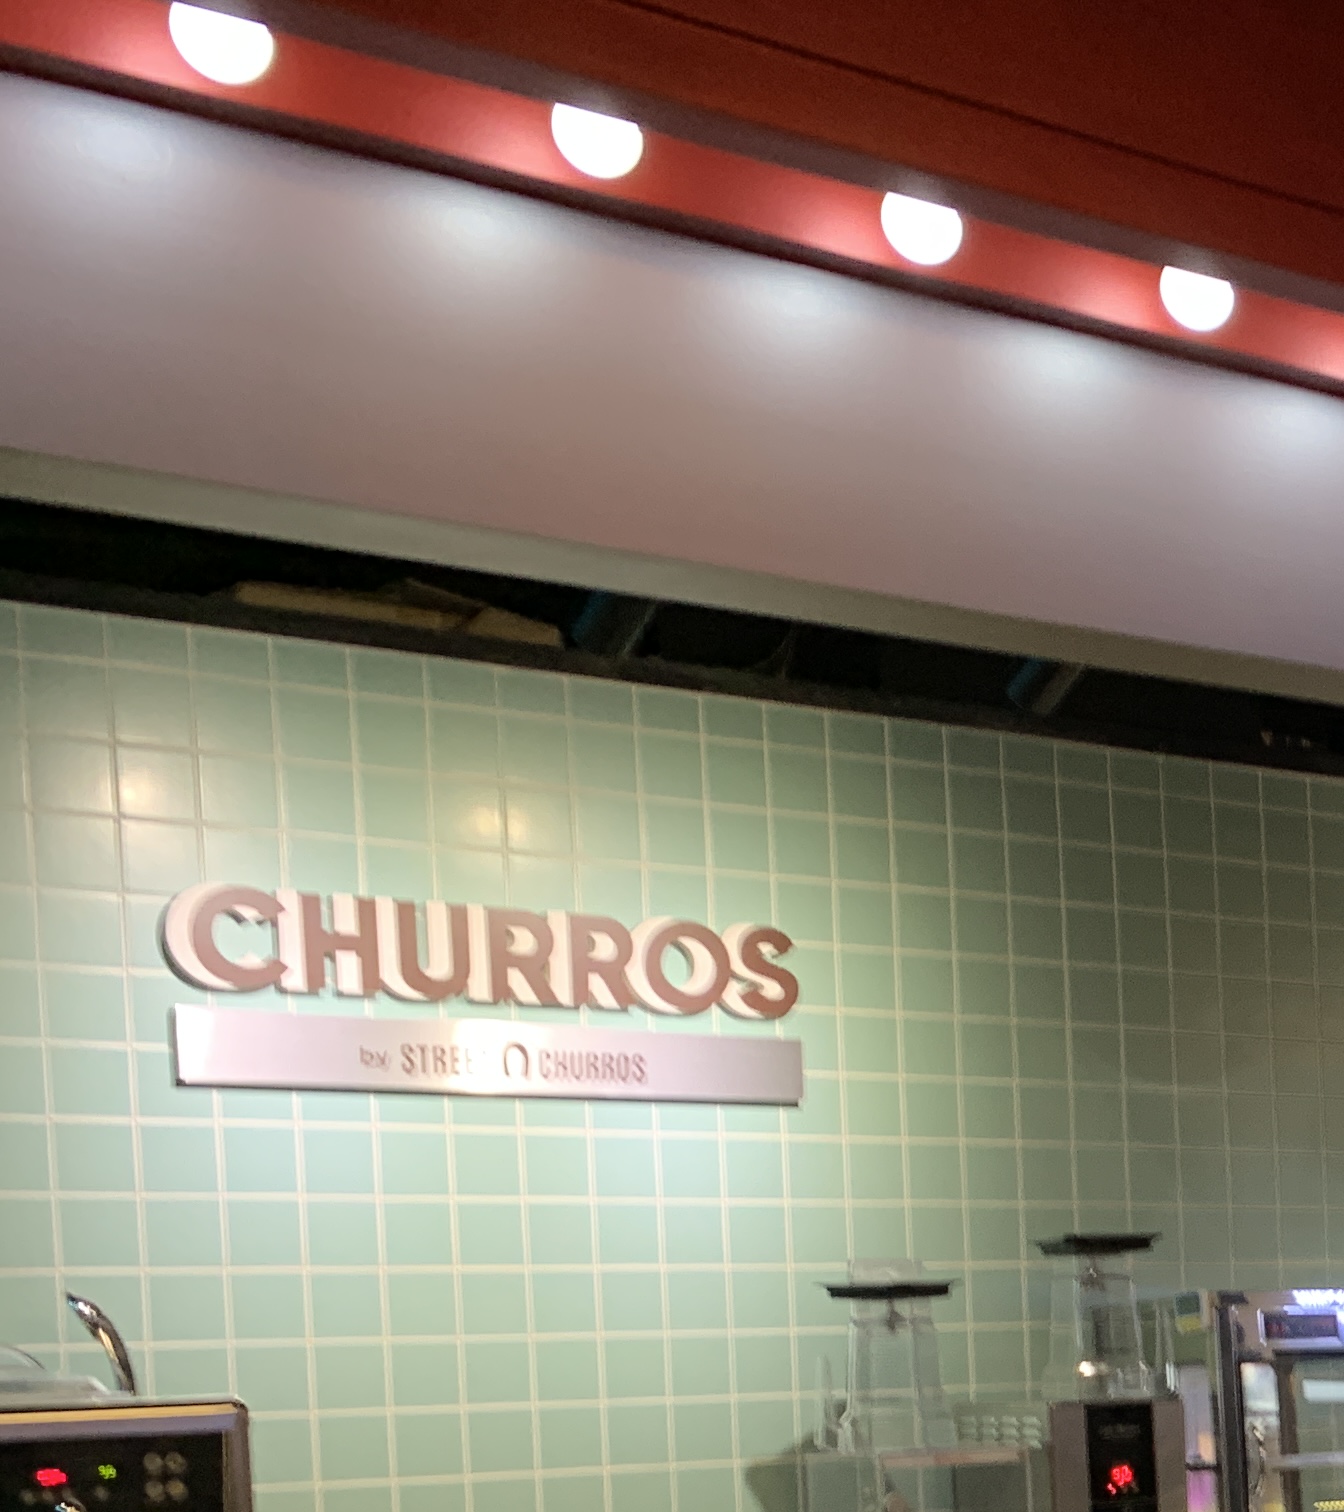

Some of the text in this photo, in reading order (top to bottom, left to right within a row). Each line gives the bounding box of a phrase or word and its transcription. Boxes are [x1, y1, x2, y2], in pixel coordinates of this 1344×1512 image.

[164, 883, 800, 1020] CHURROS
[359, 1043, 649, 1082] by STREE CHURROS
